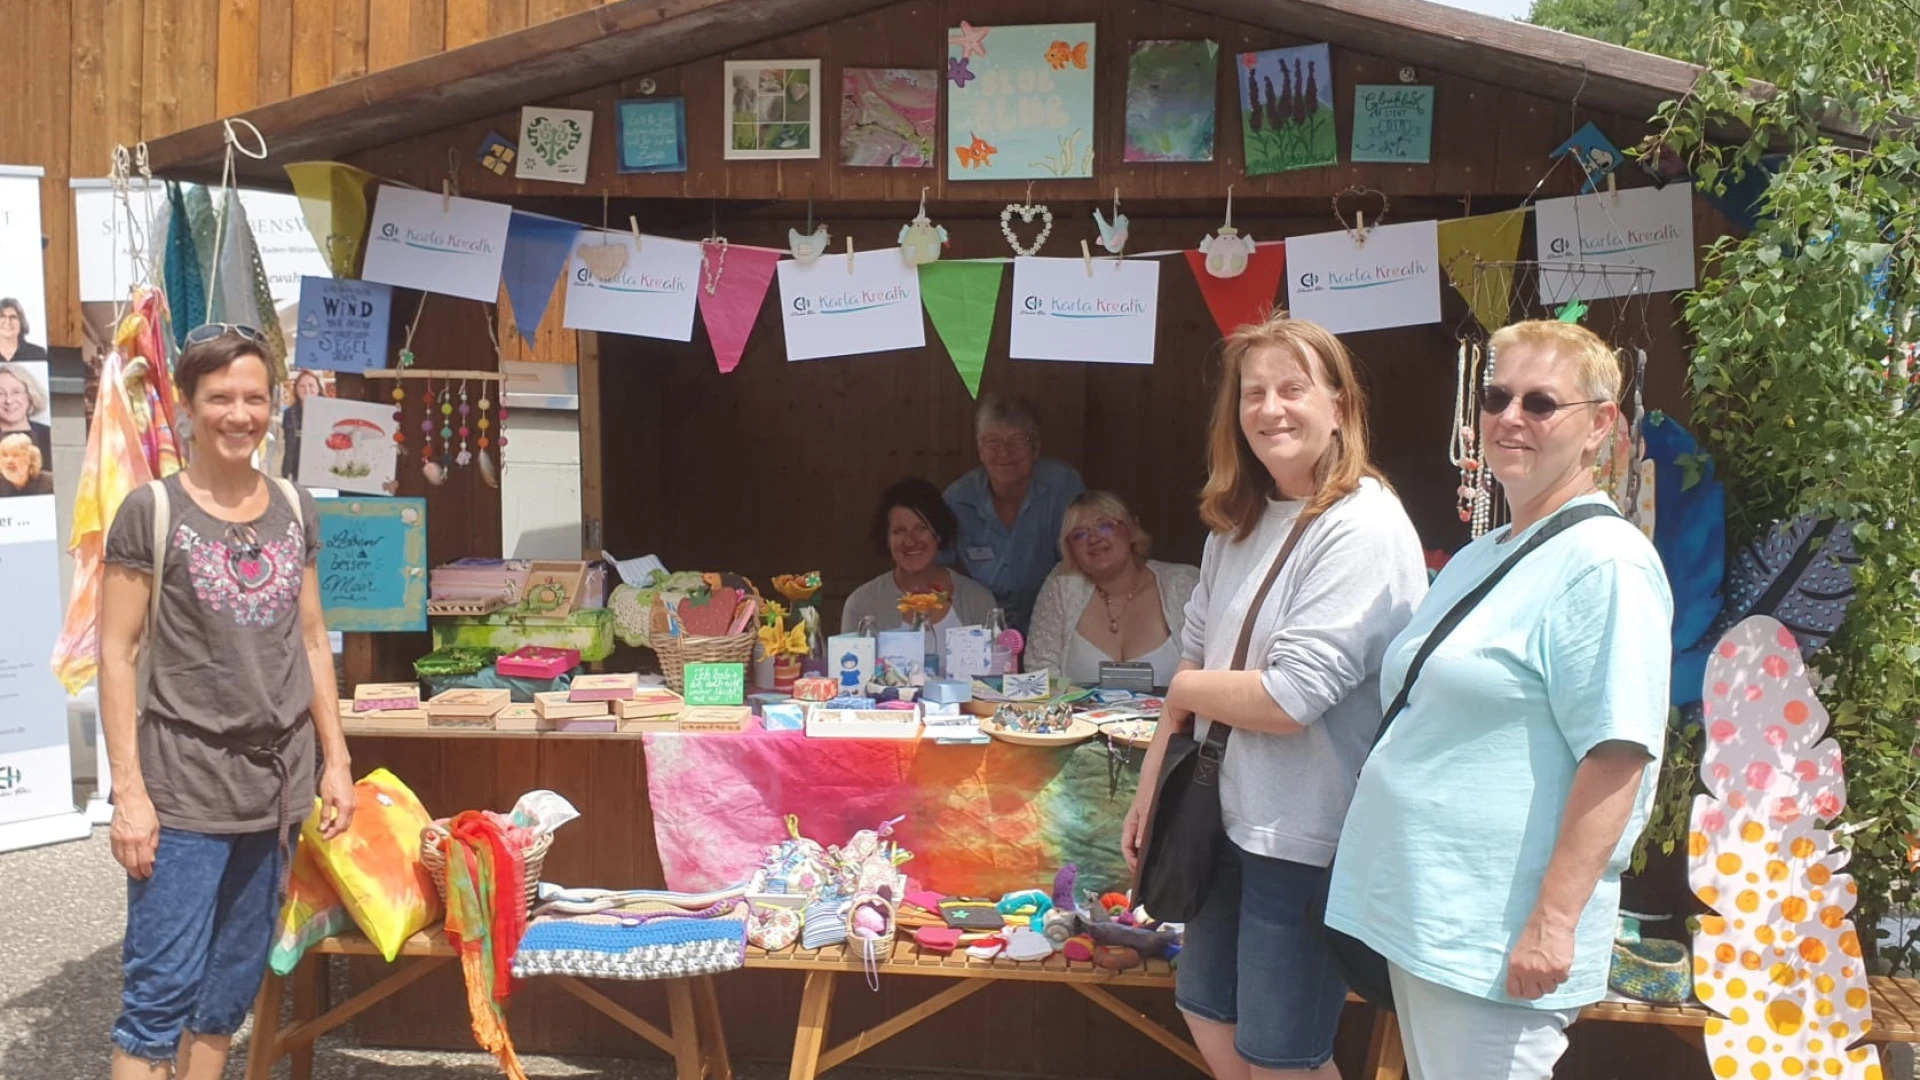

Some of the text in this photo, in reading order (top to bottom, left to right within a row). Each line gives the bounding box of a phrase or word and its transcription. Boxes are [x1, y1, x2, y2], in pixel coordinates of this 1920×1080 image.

[406, 228, 444, 244] Karla
[1580, 224, 1681, 250] Karla Kreativ
[1328, 259, 1429, 284] Karla Kreativ
[640, 272, 688, 292] Kreativ
[819, 285, 911, 309] Karla Kreativ
[1051, 297, 1148, 313] Karla Kreativ
[330, 552, 371, 571] besser
